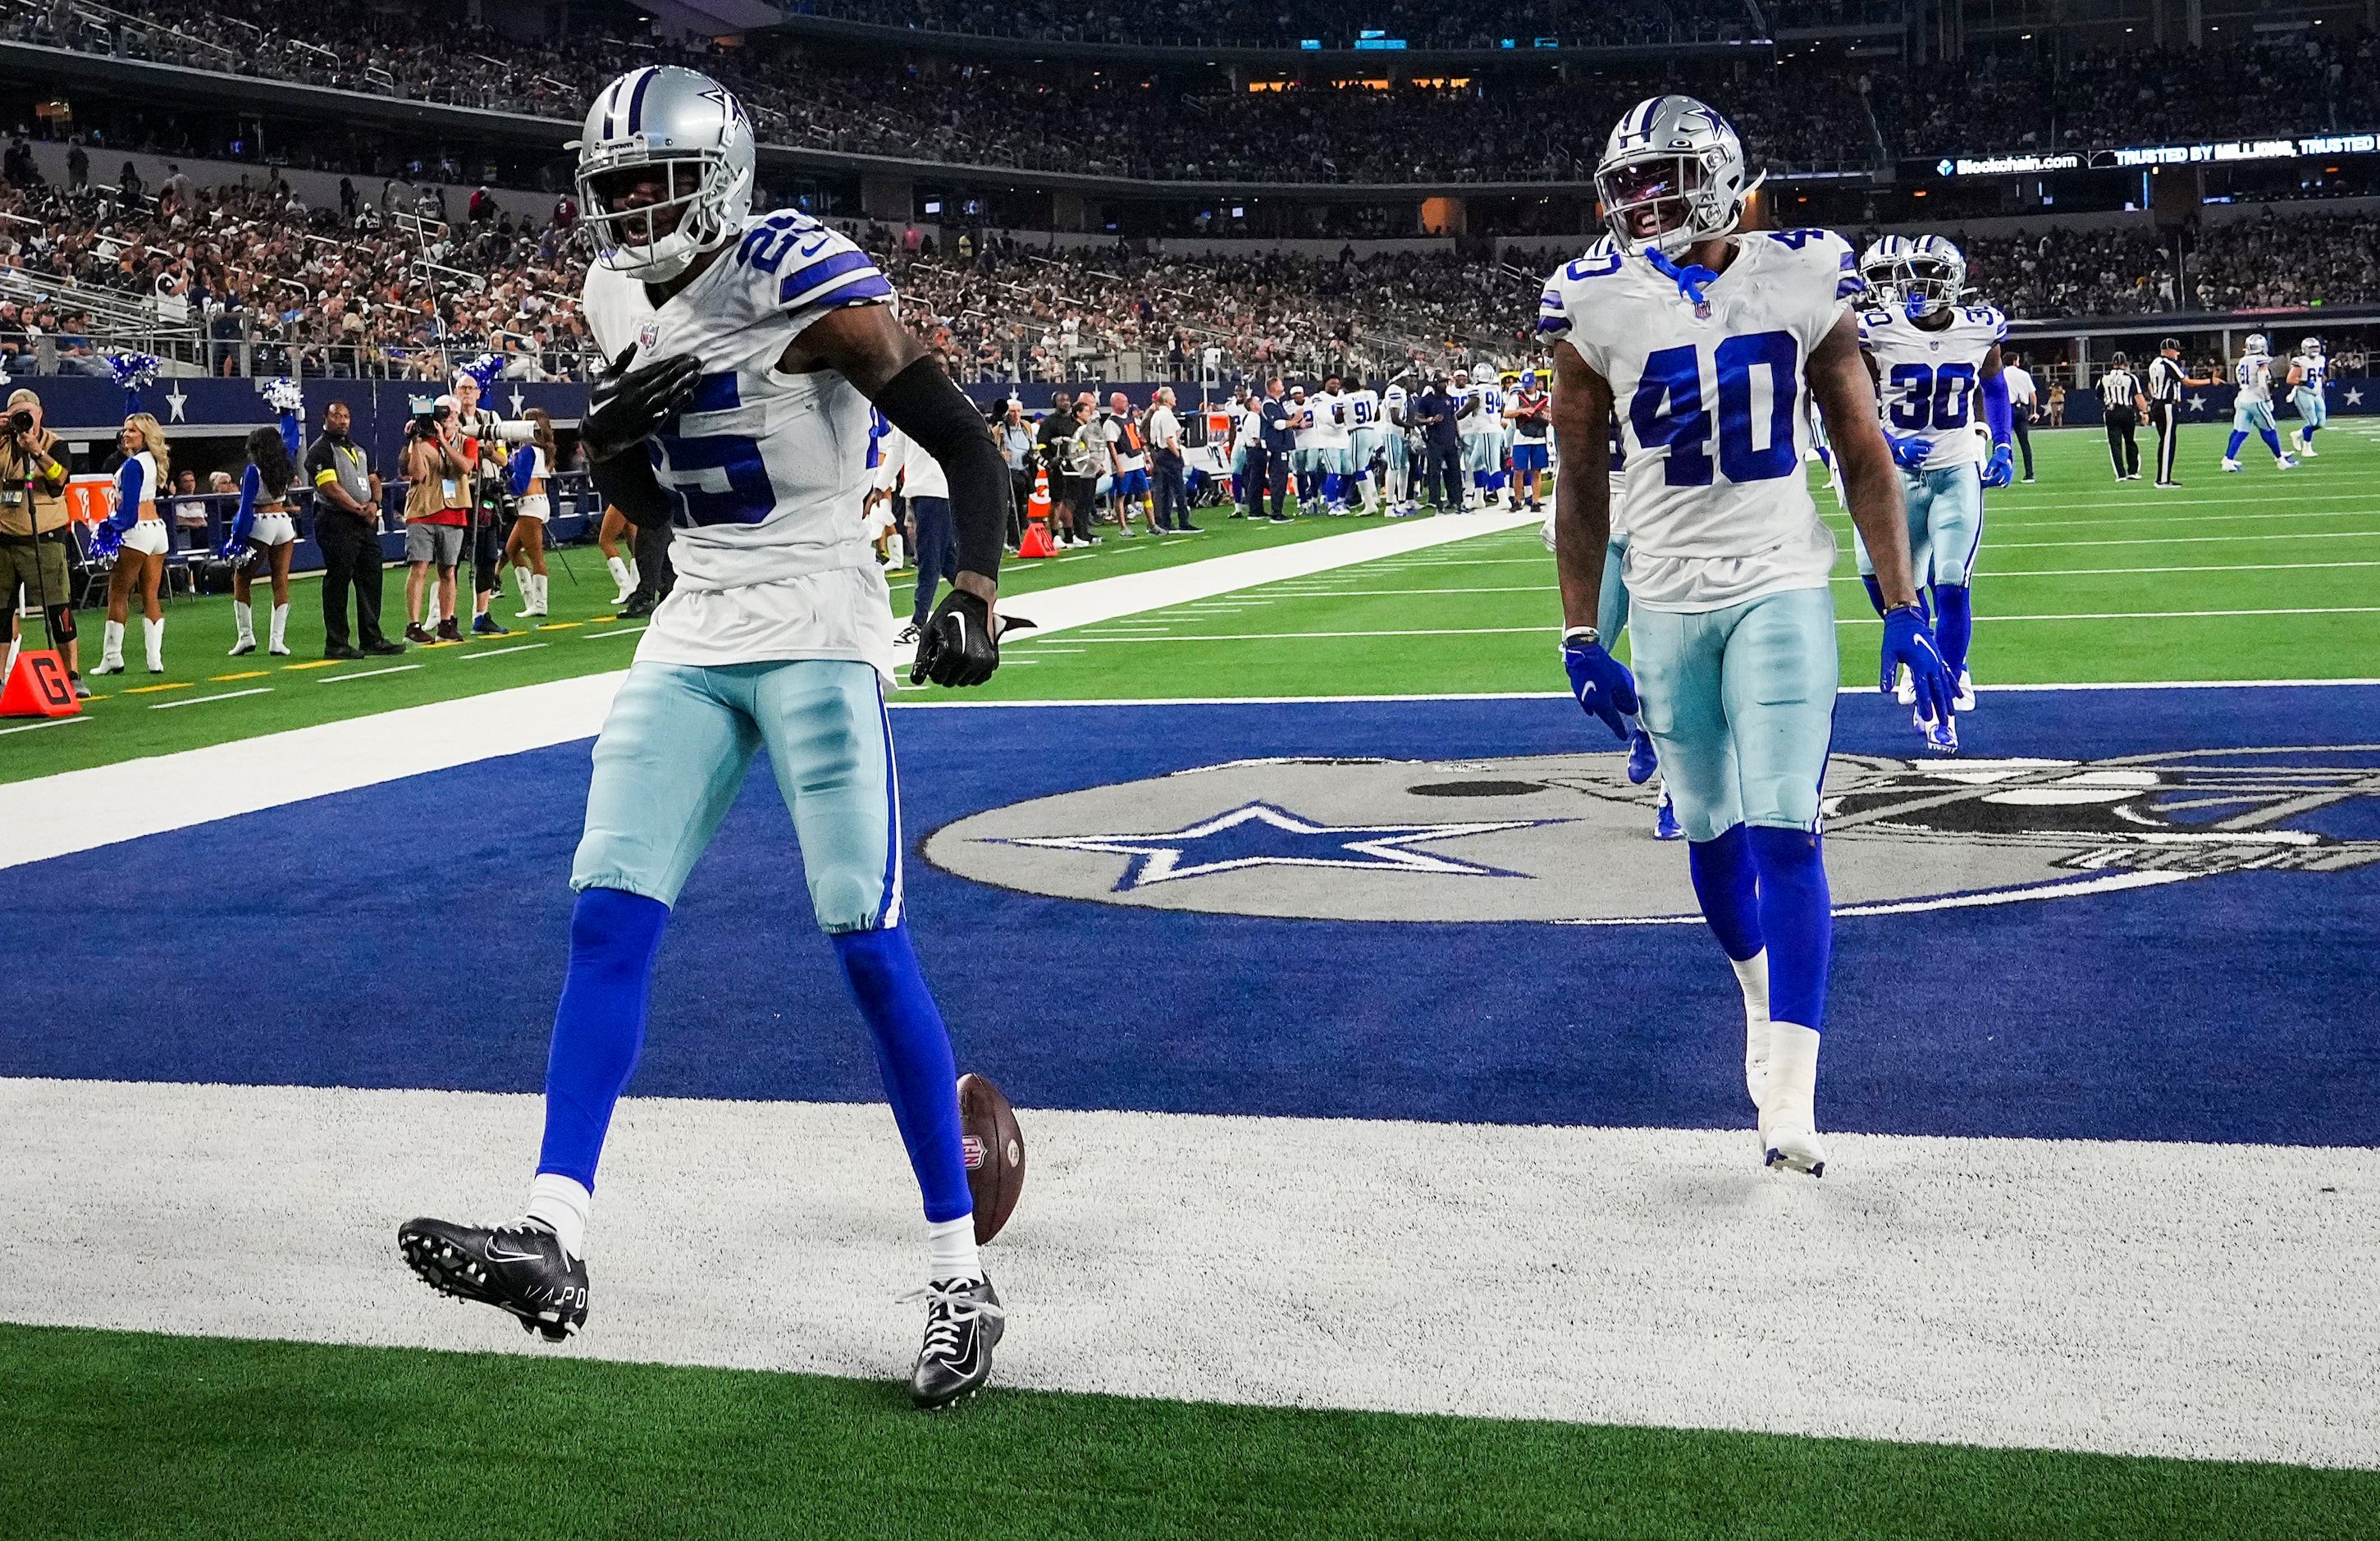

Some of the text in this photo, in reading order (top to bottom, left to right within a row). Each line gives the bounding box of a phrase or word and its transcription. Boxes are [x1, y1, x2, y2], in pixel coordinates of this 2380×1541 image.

[2114, 148, 2188, 165] TRUSTED
[2190, 144, 2213, 162] BY
[2298, 136, 2374, 155] TRUSTED
[1957, 154, 2078, 175] Blockchain.com
[1486, 391, 1501, 414] 94
[1629, 330, 1798, 487] 40
[1890, 363, 1976, 431] 30
[1354, 400, 1373, 425] 91
[32, 657, 71, 705] G
[962, 1139, 981, 1165] NFL
[524, 1284, 589, 1310] VAPO
